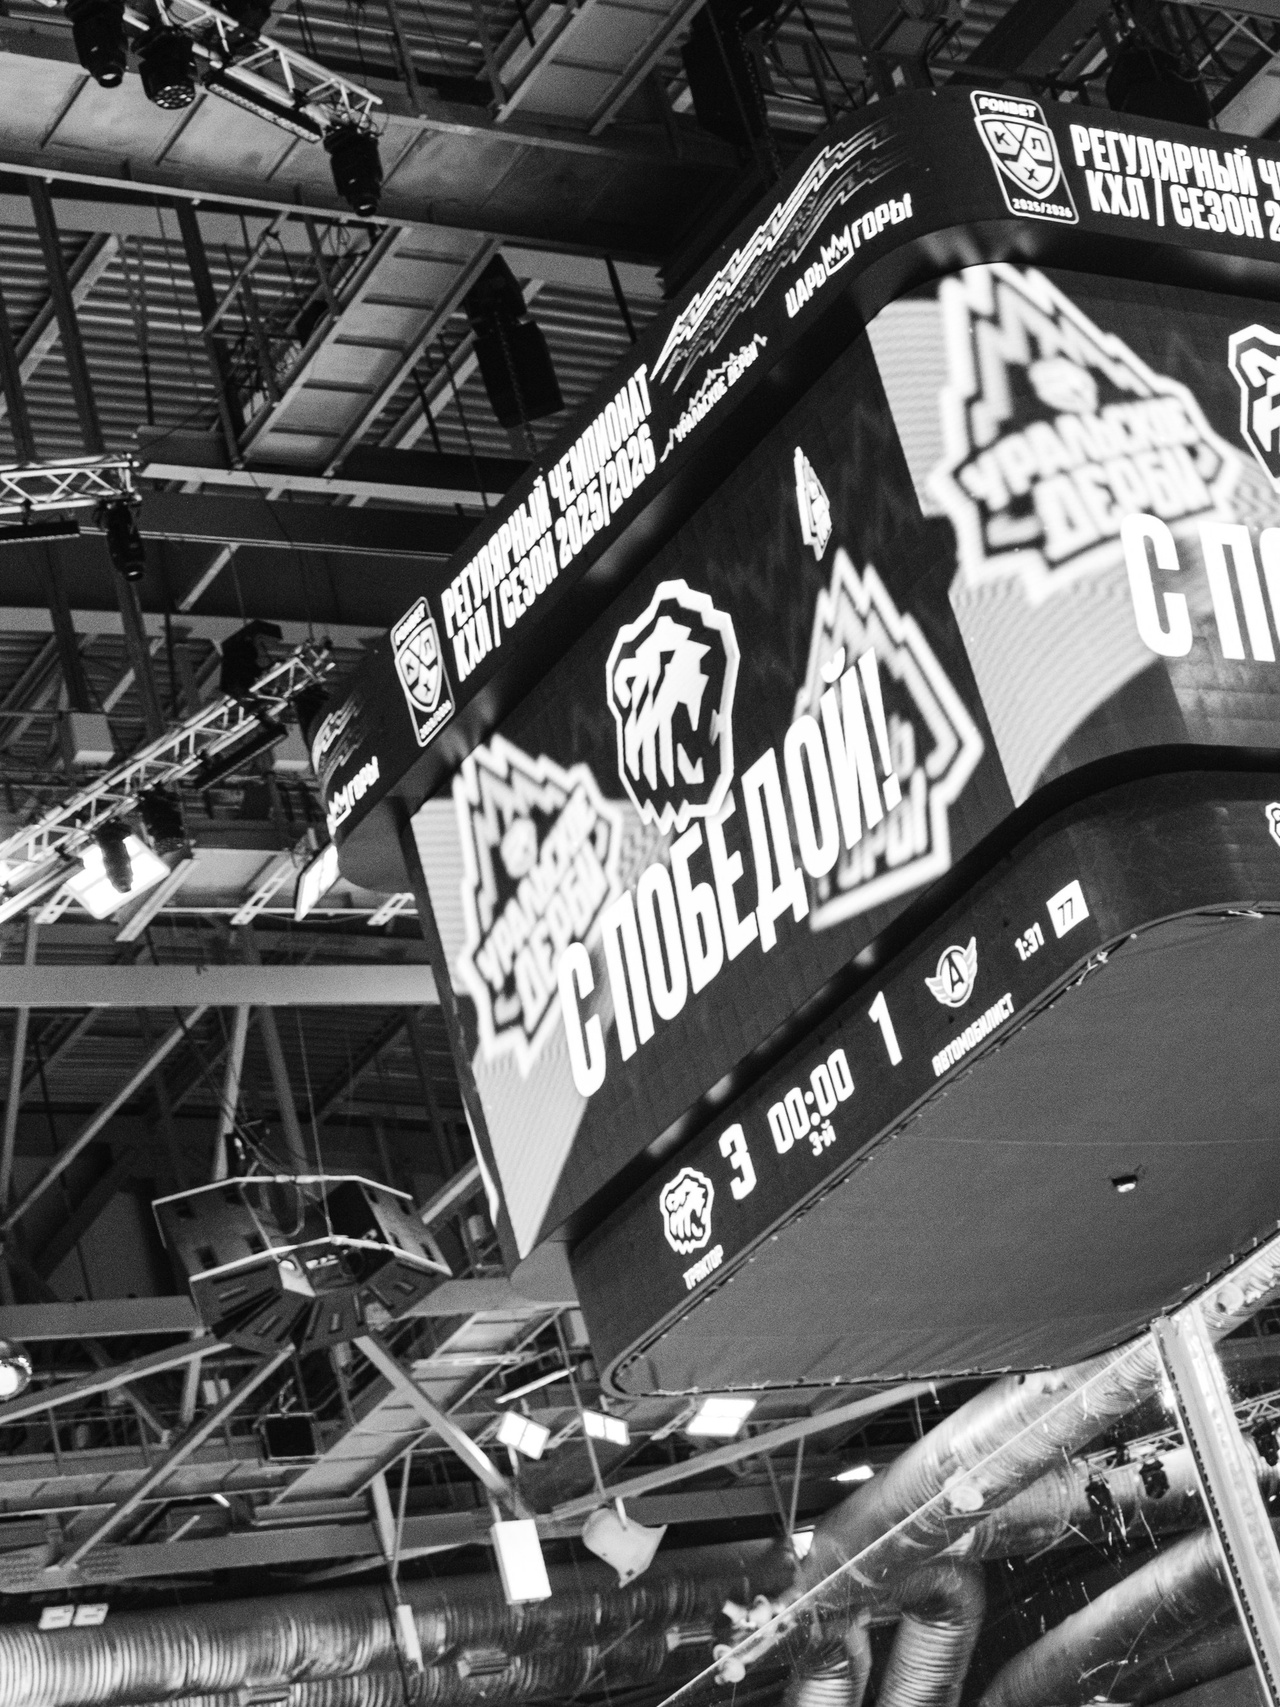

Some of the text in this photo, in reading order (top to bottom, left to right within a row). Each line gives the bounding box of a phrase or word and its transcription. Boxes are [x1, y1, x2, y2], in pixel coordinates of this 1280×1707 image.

[979, 97, 1038, 118] FONBET
[1069, 124, 1259, 197] РЕГУЛЯРНЫЙ
[1085, 169, 1150, 220] КХЛ
[1169, 184, 1265, 239] СЕЗОН
[785, 192, 913, 318] ЦАРЬ ГОРЫ
[441, 363, 652, 639] РЕГУЛЯРНЫЙ ЧЕМПИОНАТ
[452, 604, 493, 682] КХЛ
[499, 531, 559, 628] СЕЗОН
[1120, 513, 1193, 657] С
[557, 942, 606, 1098] С
[600, 646, 902, 1061] ПОБЕДОЙ!
[1014, 921, 1045, 961] 1:31
[931, 992, 1015, 1077] АВТОМОБИЛИСТ
[718, 990, 903, 1200] 3 00:00 1
[682, 1244, 724, 1290] ТРАКТОР
